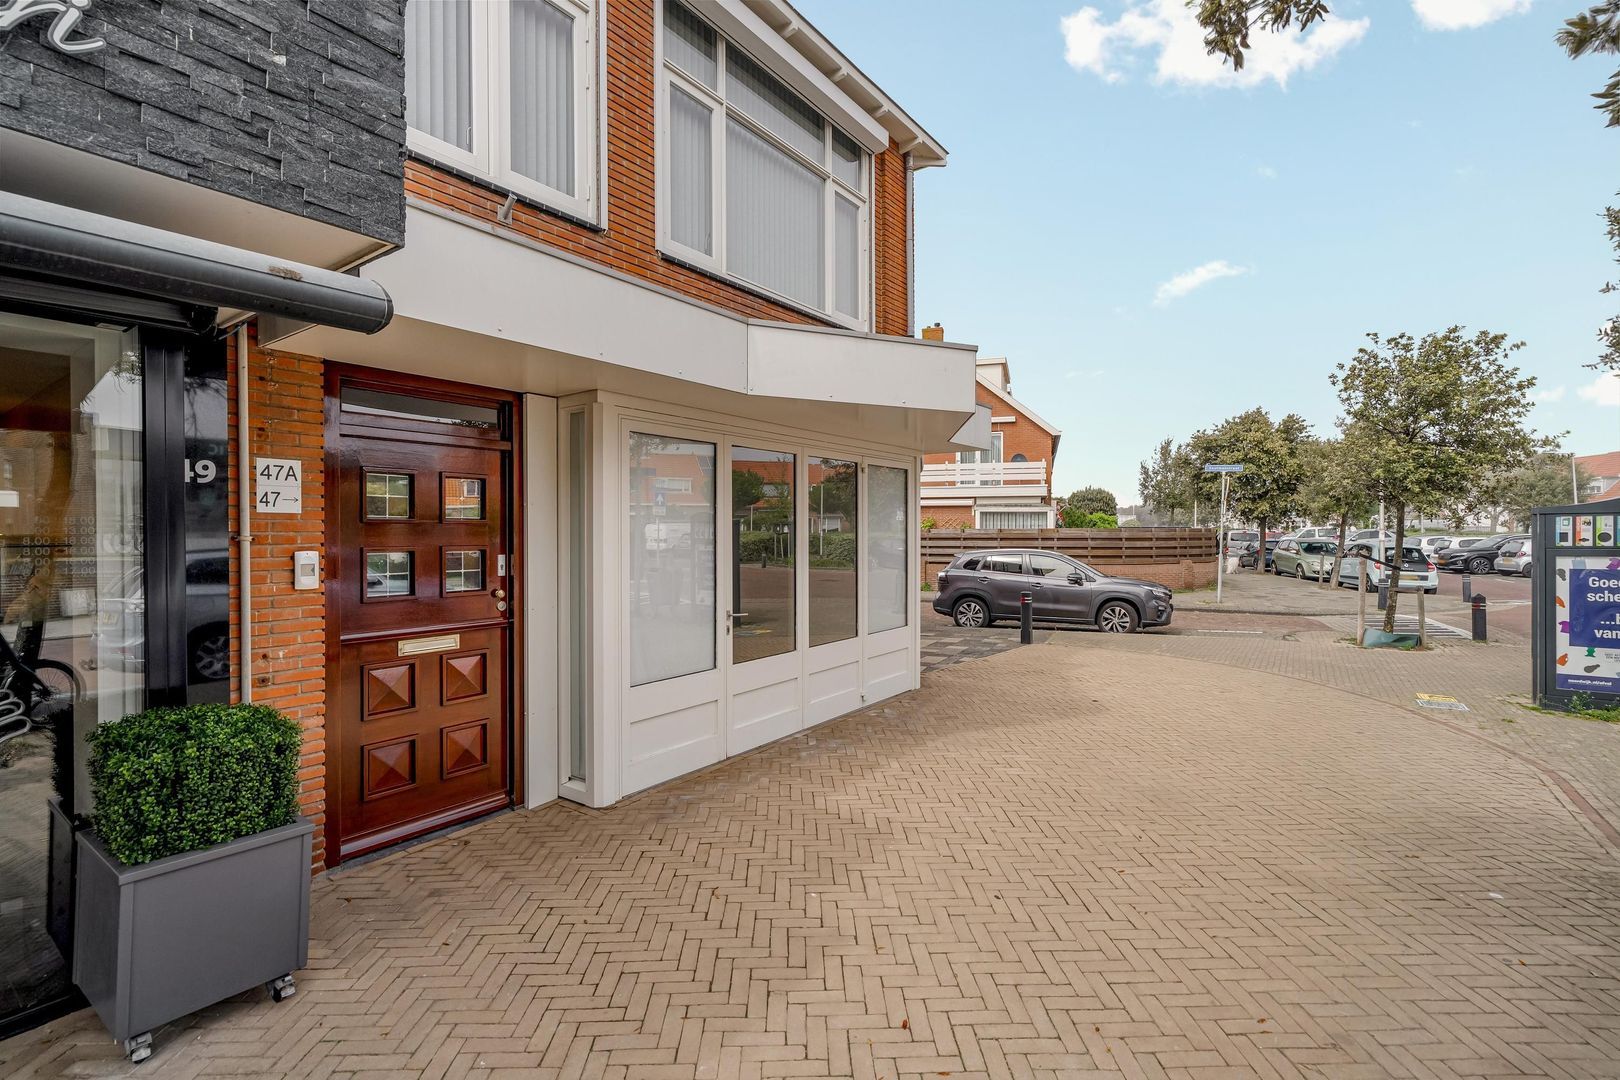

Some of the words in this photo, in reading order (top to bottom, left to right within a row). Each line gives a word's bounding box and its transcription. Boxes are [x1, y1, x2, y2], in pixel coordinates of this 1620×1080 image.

[260, 464, 298, 481] 47A
[259, 491, 281, 507] 47
[1589, 577, 1620, 588] Goe
